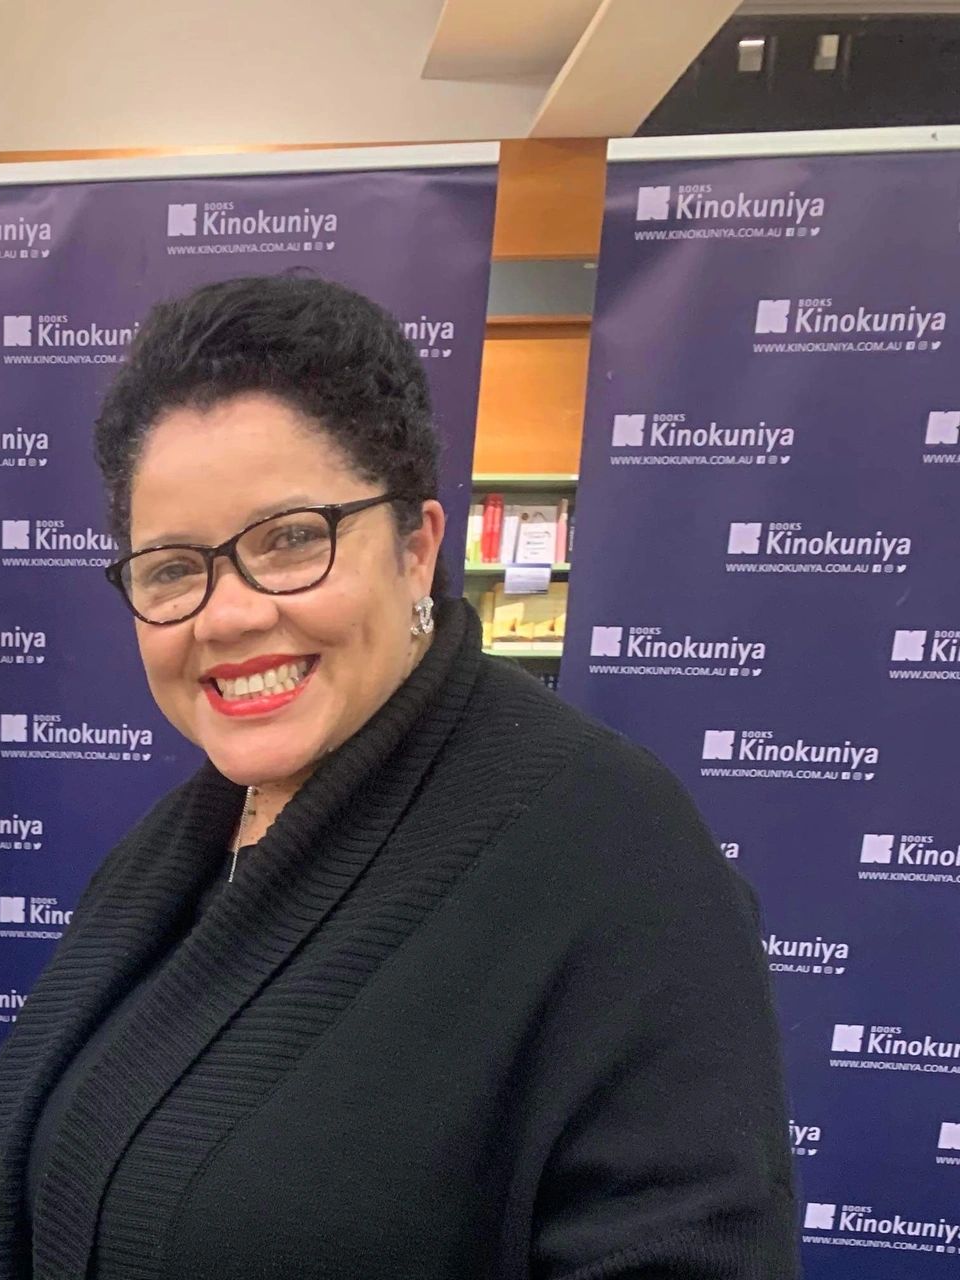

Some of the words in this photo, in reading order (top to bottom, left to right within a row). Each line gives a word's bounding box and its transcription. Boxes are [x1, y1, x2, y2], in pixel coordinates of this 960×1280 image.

[678, 185, 712, 193] BOOKS
[204, 202, 234, 211] BOOKS
[676, 192, 825, 224] Kinokuniya
[202, 208, 338, 239] Kinokuniya
[634, 227, 782, 241] WWW.KINOKUNIYA.COM.AU
[167, 241, 300, 255] WWW.KINOKUNIYA.COM.AU
[798, 299, 832, 307] BOOKS
[795, 306, 946, 337] Kinokuniya
[400, 315, 454, 345] niya
[753, 341, 902, 353] WWW.KINOKUNIYA.COM.AU
[653, 414, 686, 422] BOOKS
[650, 422, 795, 452] Kinokuniya
[610, 456, 754, 465] WWW.KINOKUNIYA.COM.AU
[36, 520, 64, 528] BOOKS
[769, 523, 802, 531] BOOKS
[766, 531, 911, 561] Kinokuniya
[726, 564, 869, 574] WWW.KINOKUNIYA.COM.AU
[629, 627, 661, 635] BOOKS
[627, 635, 766, 665] Kinokuniya
[589, 665, 727, 676] WWW.KINOKUNIYA.COM.AU
[33, 722, 153, 750] Kinokuniya
[742, 731, 773, 739] BOOKS
[1, 750, 121, 761] WWW.KINOKUNIYA.COM.AU
[739, 739, 879, 769] Kinokuniya
[701, 768, 838, 780] WWW.KINOKUNIYA.COM.AU
[901, 835, 934, 843] BOOKS
[802, 1235, 934, 1252] WWW.KINOKUNIYA.COM.AU
